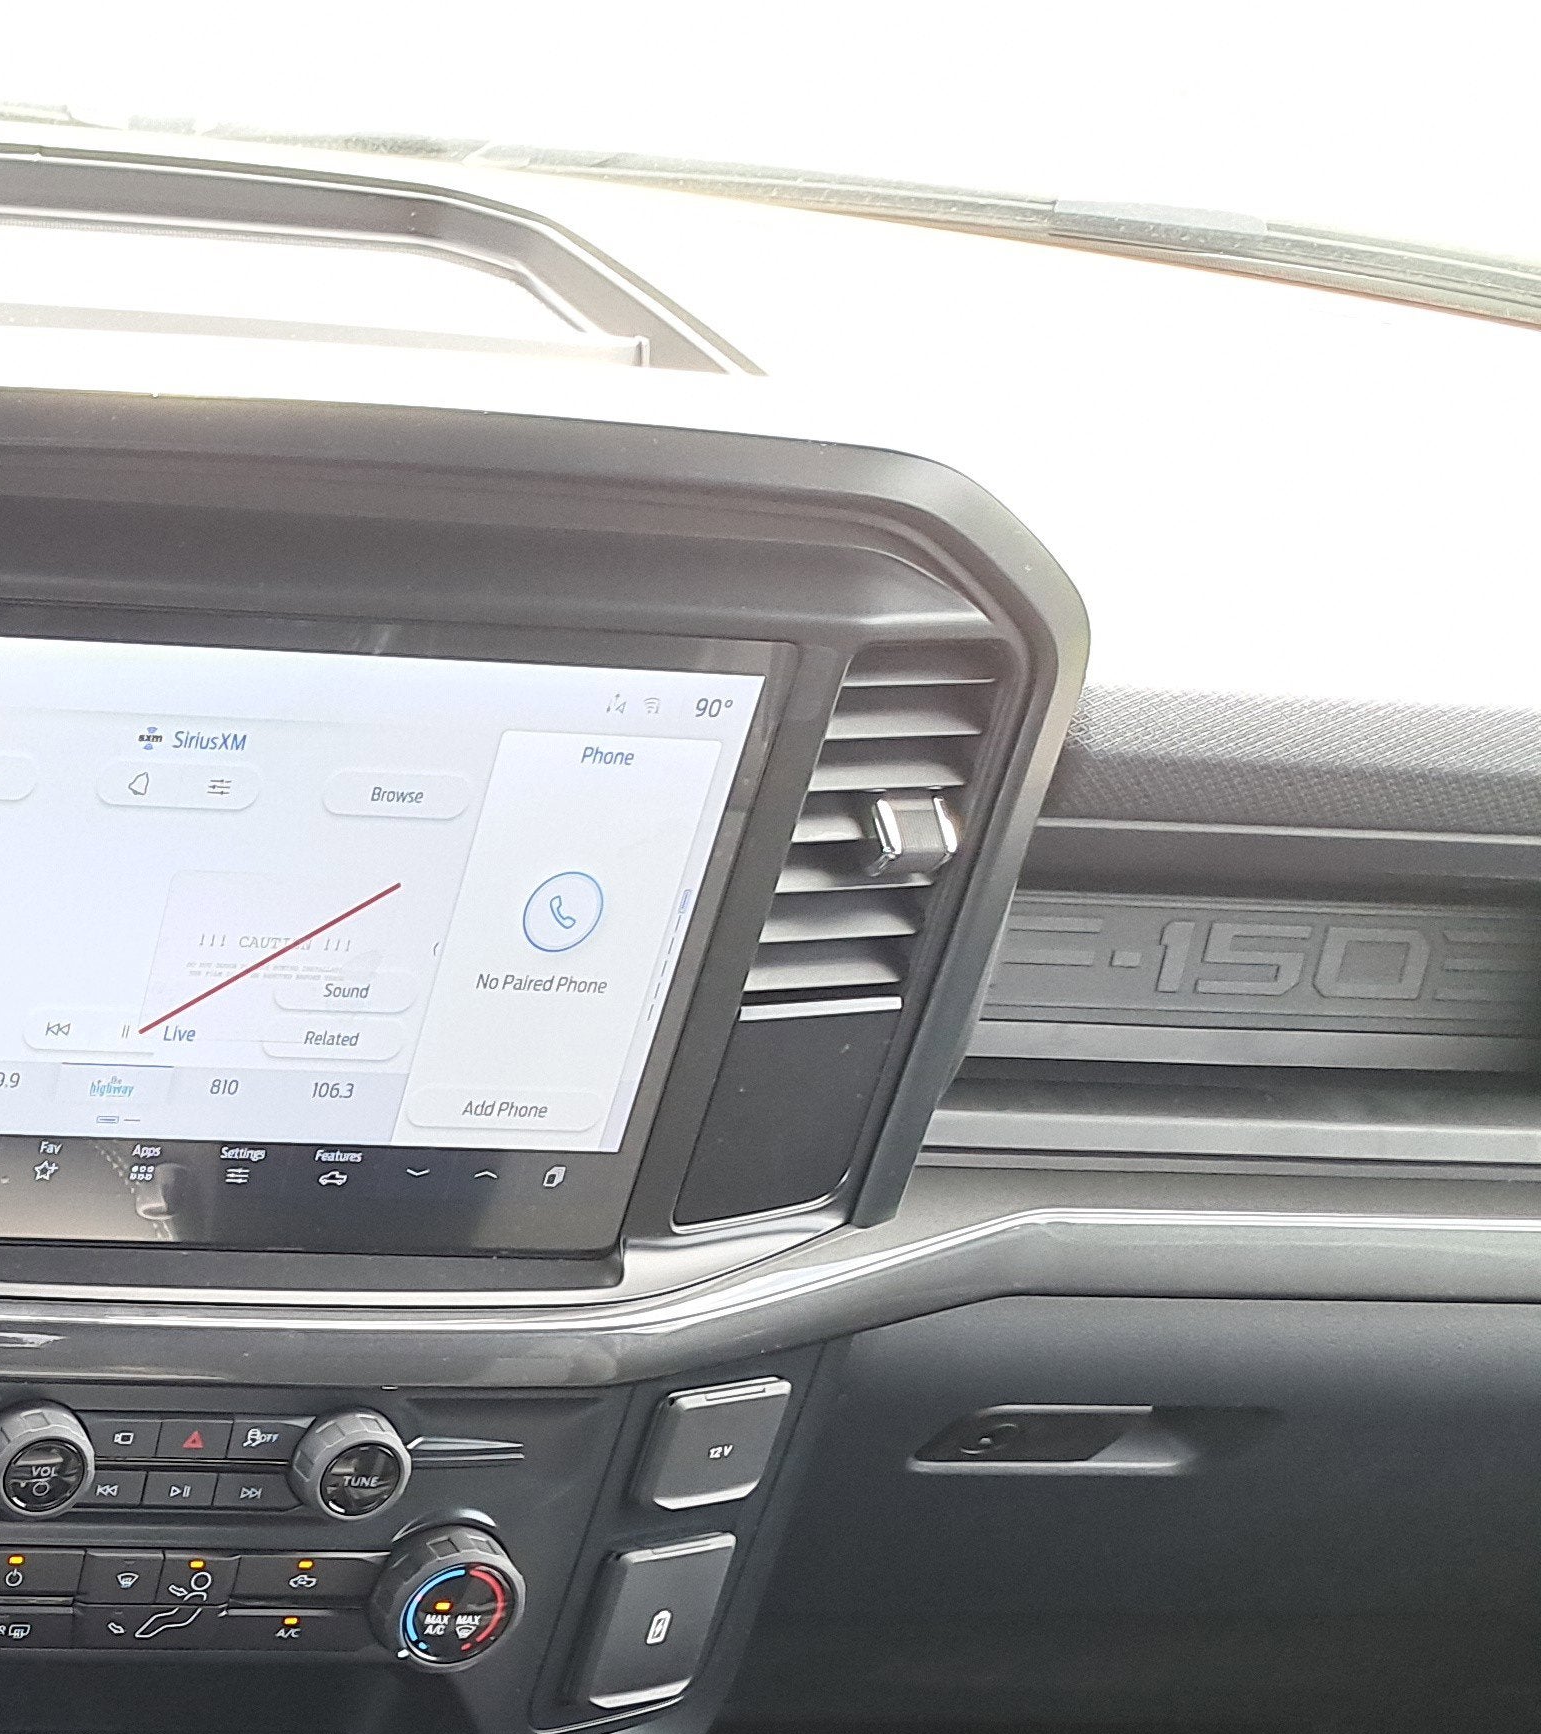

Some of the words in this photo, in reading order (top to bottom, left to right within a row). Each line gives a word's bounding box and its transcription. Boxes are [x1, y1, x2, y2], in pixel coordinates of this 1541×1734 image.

[172, 730, 247, 751] SiriusXM
[580, 746, 635, 766] Phone
[371, 786, 424, 804] Browse
[239, 935, 312, 951] CAUTIN
[323, 982, 371, 999] Sound
[475, 973, 499, 991] No
[501, 974, 554, 992] Paired
[555, 975, 609, 995] Phone
[163, 1025, 196, 1042] Live
[304, 1030, 360, 1047] Related
[209, 1078, 240, 1096] 810
[311, 1081, 355, 1099] 106.3
[461, 1100, 494, 1117] Add
[497, 1101, 548, 1119] Phone
[39, 1141, 63, 1155] Fav
[131, 1144, 162, 1159] Apps
[220, 1146, 266, 1162] Settings
[314, 1149, 363, 1163] Features
[31, 1465, 58, 1478] VOL
[343, 1475, 379, 1488] TUNE
[275, 1628, 301, 1639] A/C
